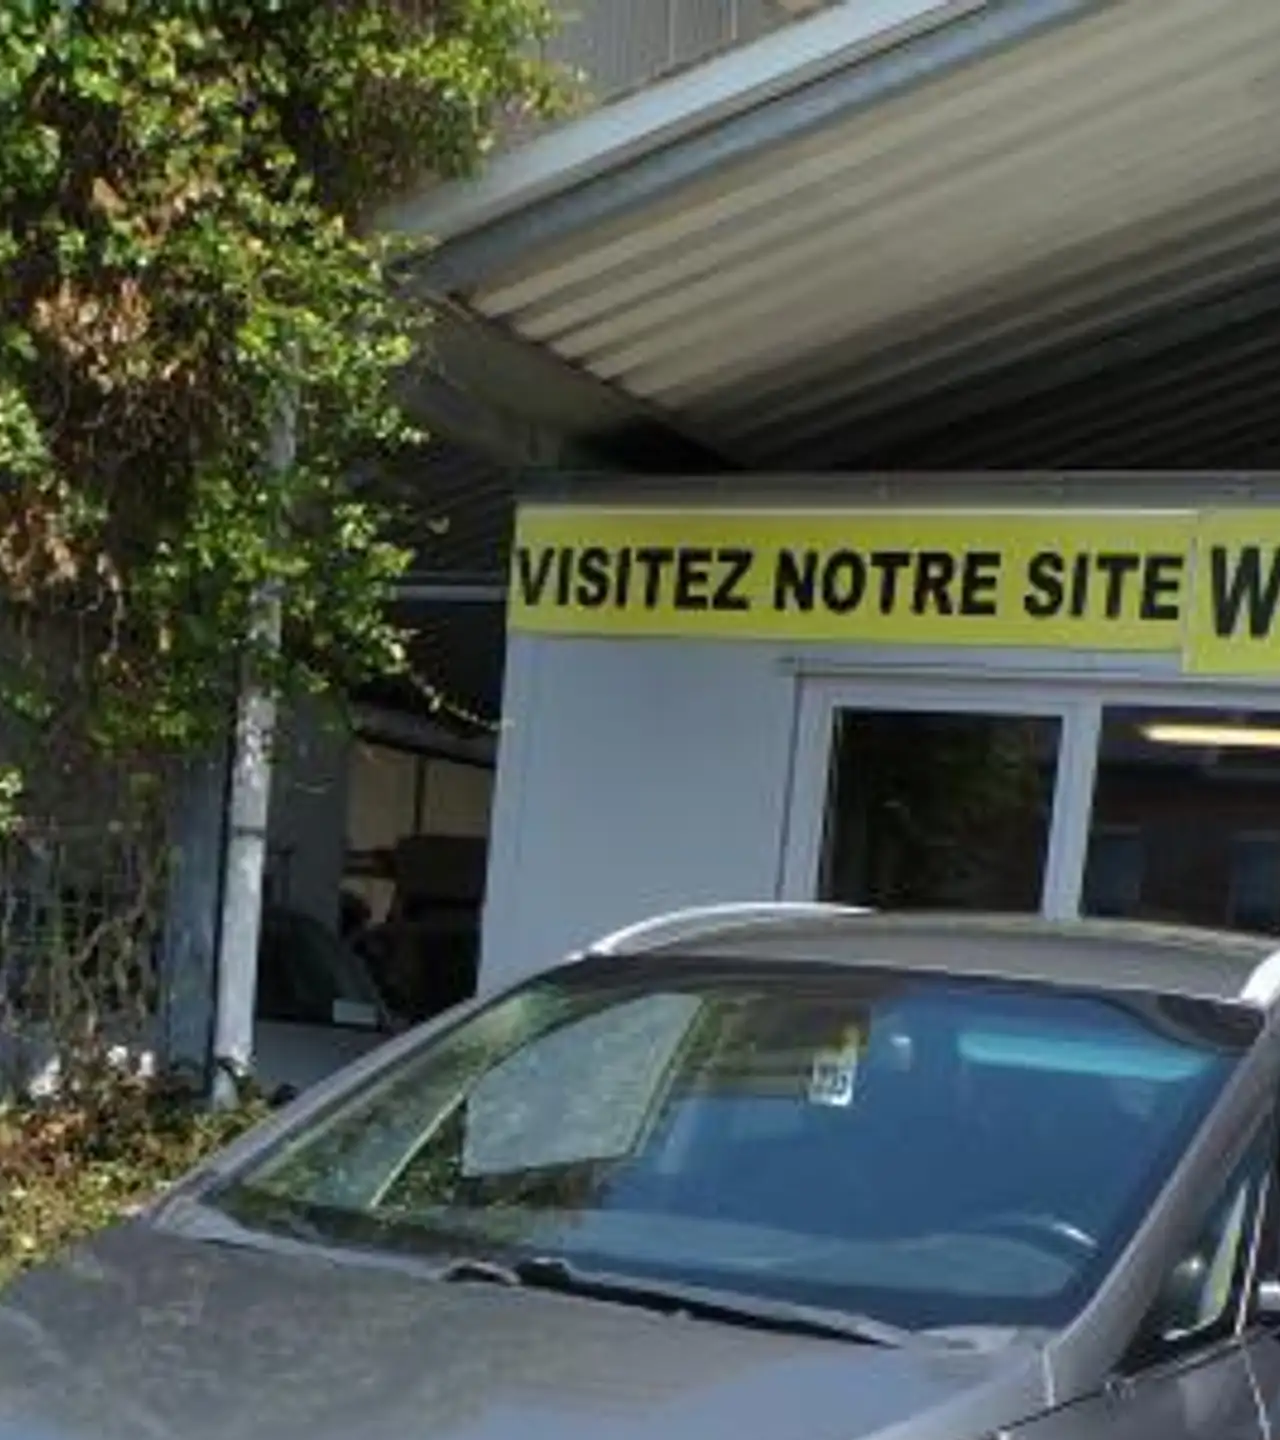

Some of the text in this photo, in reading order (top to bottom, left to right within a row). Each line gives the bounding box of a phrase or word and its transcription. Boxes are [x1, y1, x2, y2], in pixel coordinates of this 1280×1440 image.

[519, 546, 1184, 621] VISITEZ NOTRE SITE
